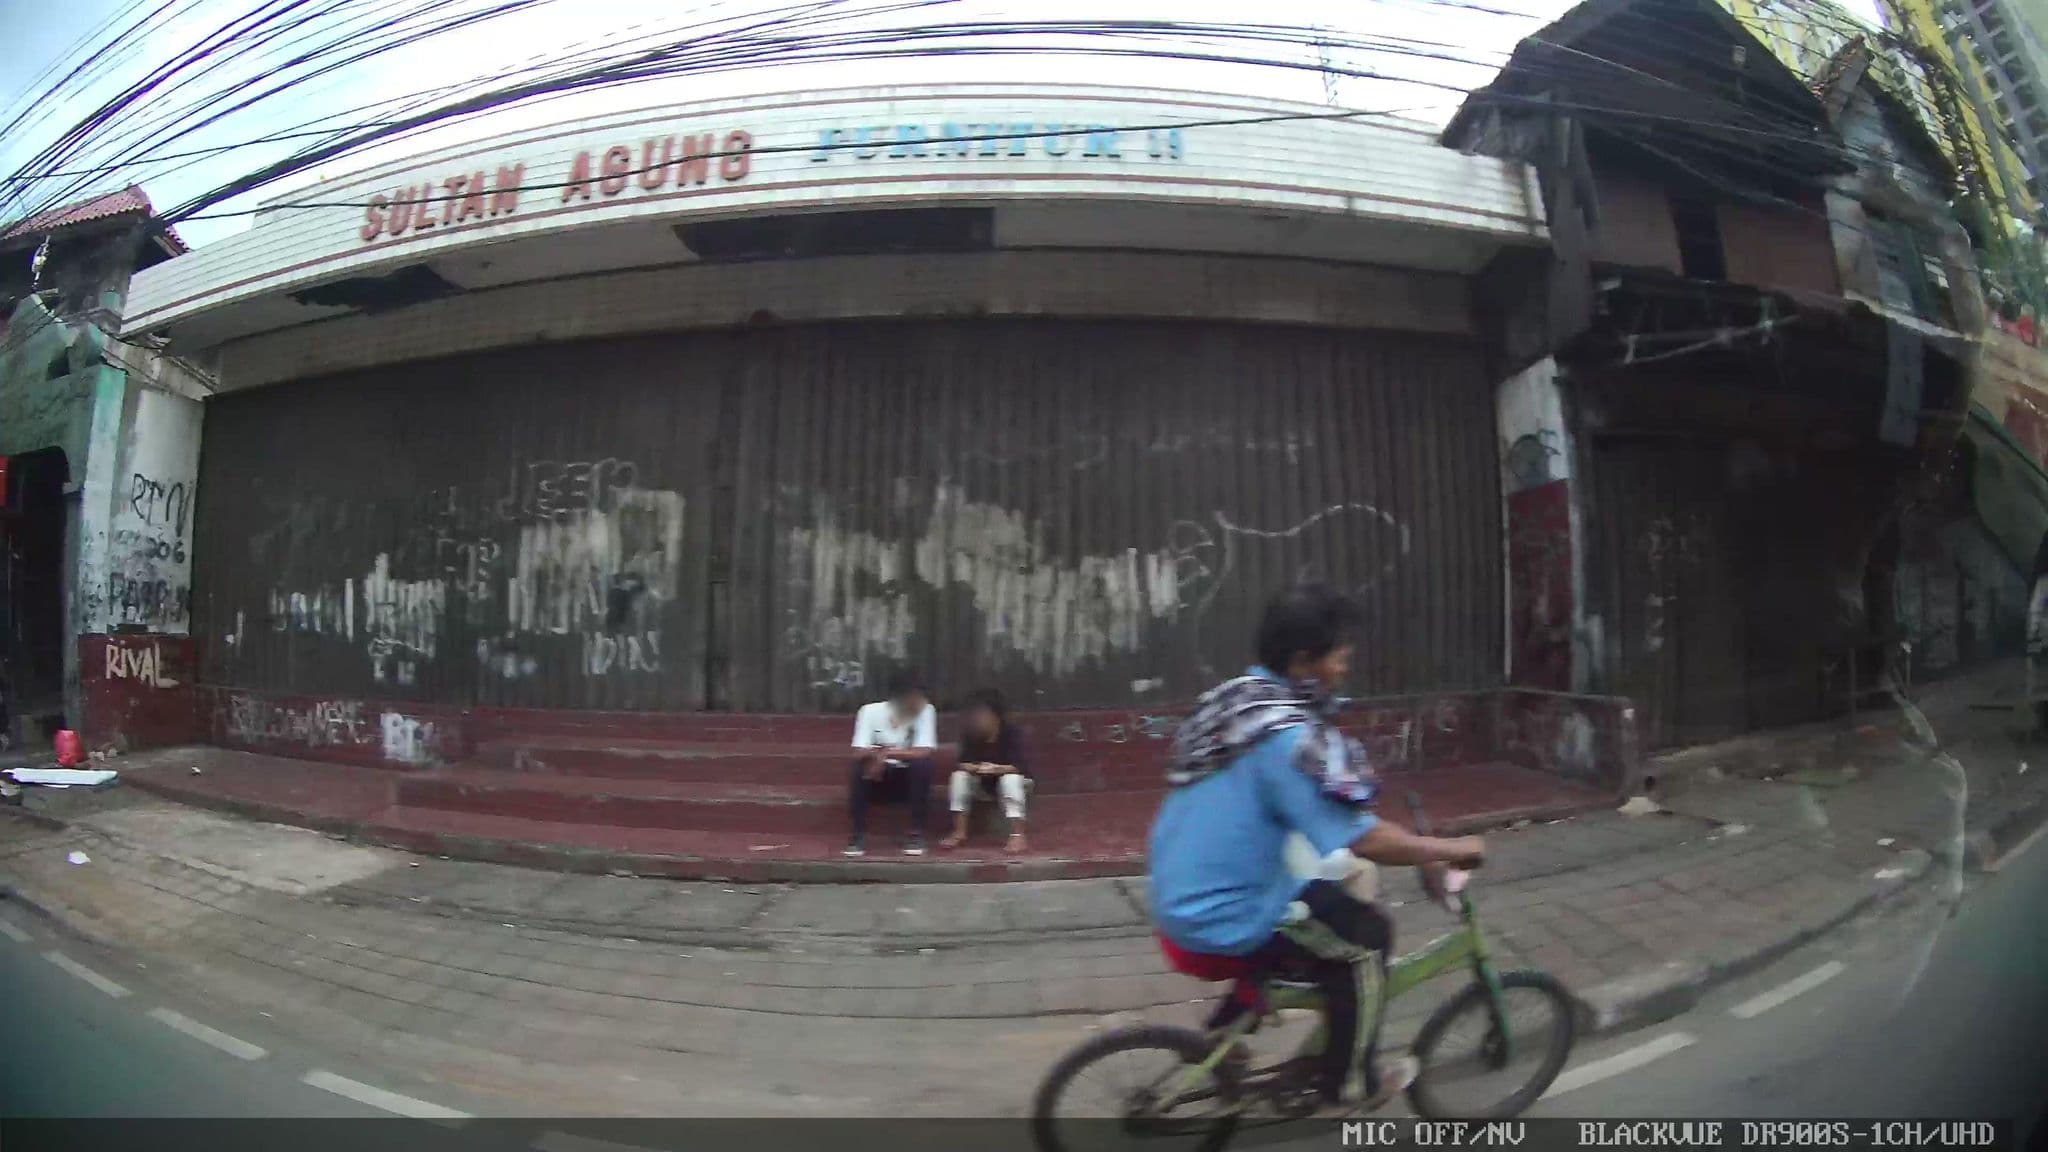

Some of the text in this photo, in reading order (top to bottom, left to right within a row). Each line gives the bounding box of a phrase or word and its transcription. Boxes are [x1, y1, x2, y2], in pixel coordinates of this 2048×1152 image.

[360, 163, 526, 241] SULTAN
[561, 129, 753, 203] AGUNG
[106, 642, 180, 688] RIVAL
